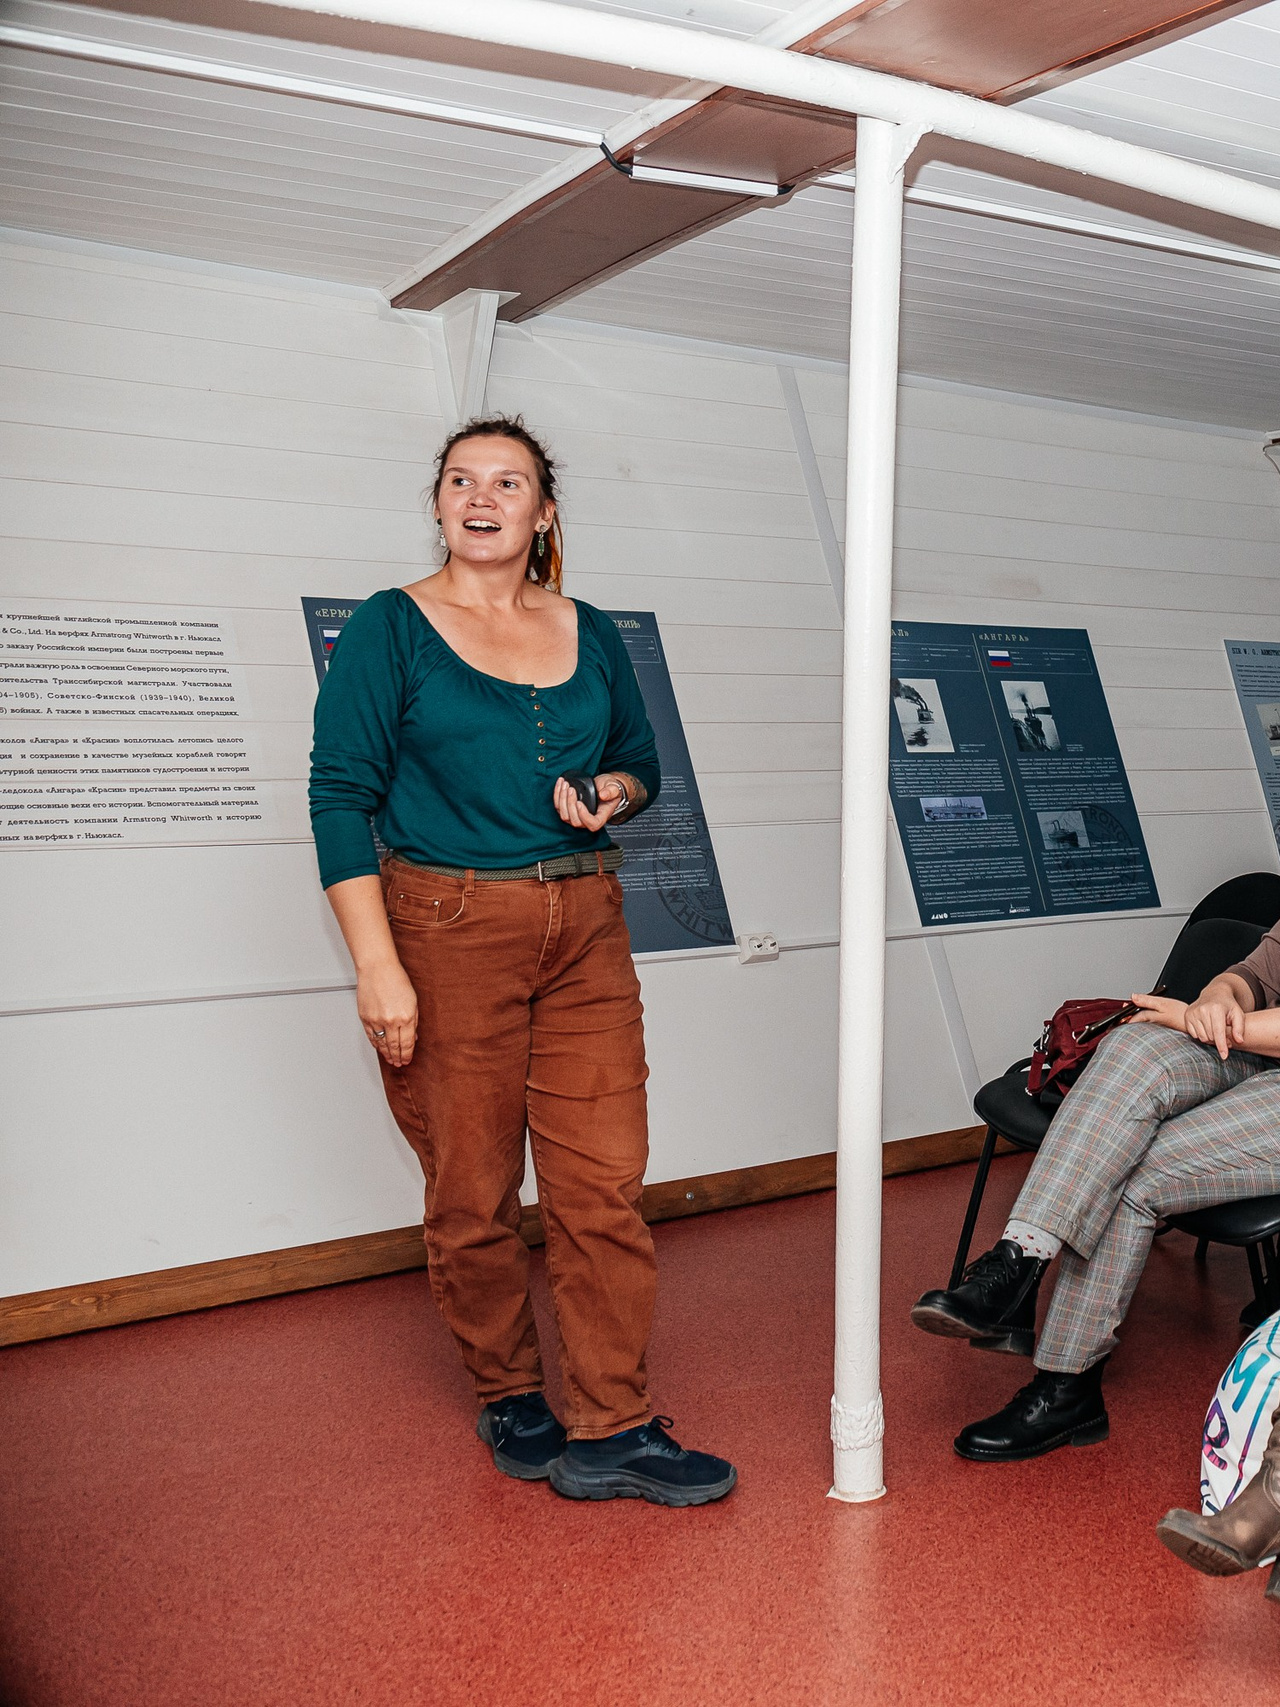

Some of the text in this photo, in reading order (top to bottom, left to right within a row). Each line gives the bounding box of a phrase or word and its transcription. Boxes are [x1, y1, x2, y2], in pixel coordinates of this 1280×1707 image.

[90, 631, 132, 640] Armstrong
[978, 632, 1030, 642] «АНГАРА»
[36, 643, 85, 651] Российской
[126, 665, 170, 673] Северного
[52, 677, 123, 686] Транссибирской
[47, 692, 136, 700] Советско-Финской
[140, 694, 195, 702] (1939–1940),
[176, 751, 214, 759] кораблей
[35, 833, 68, 842] верфях
